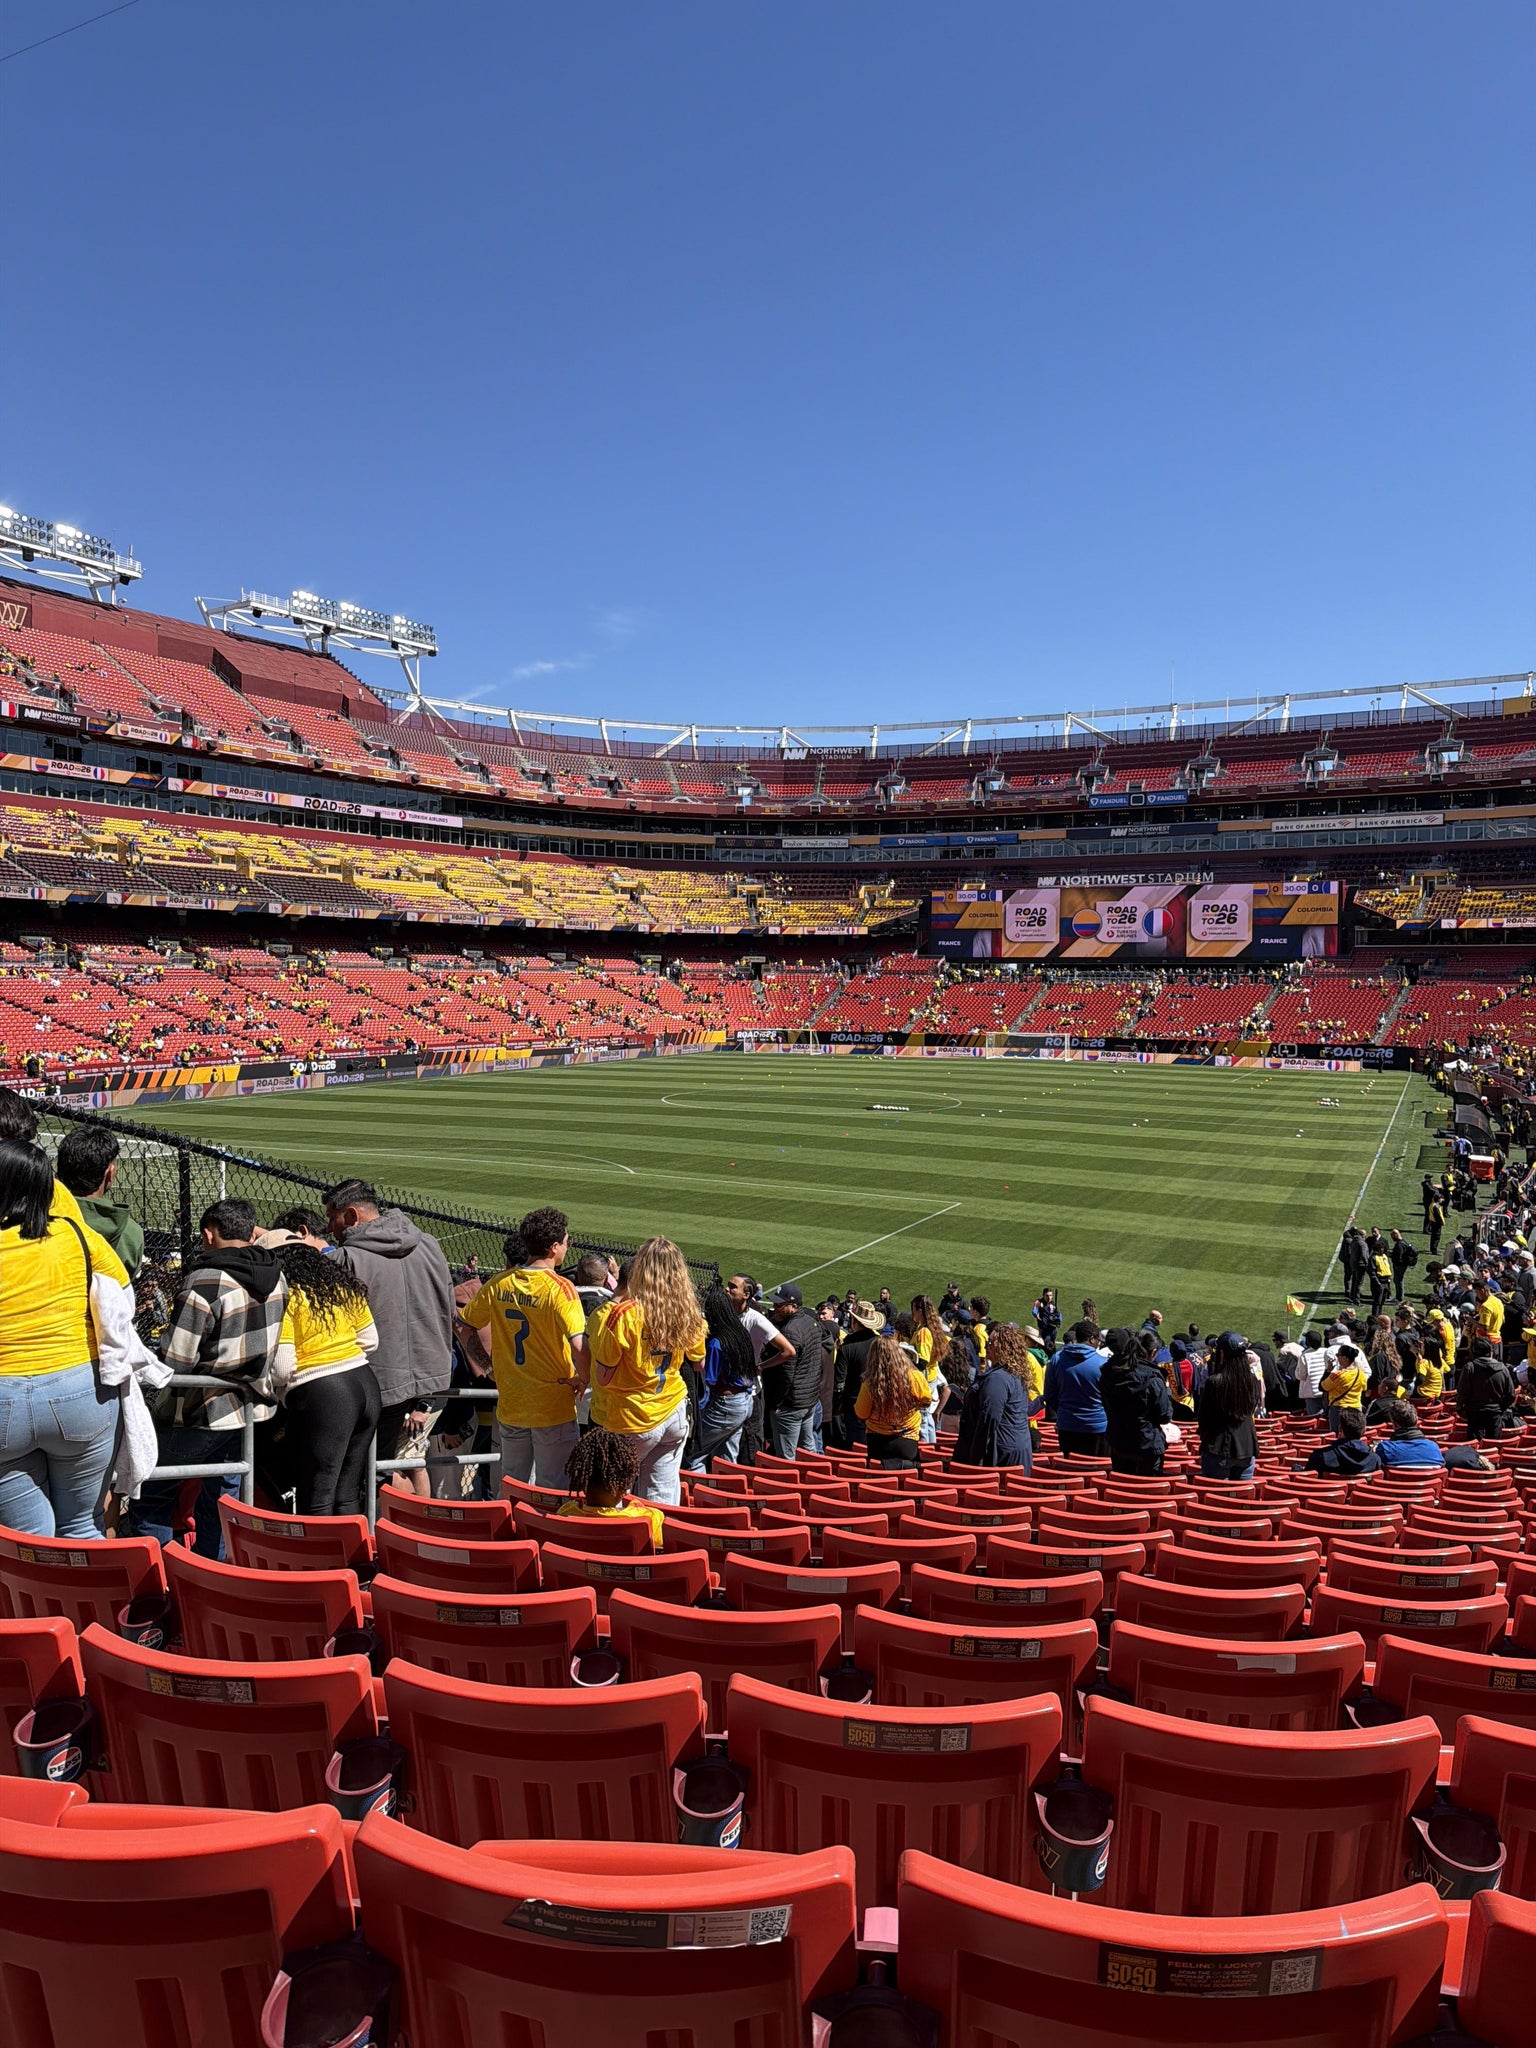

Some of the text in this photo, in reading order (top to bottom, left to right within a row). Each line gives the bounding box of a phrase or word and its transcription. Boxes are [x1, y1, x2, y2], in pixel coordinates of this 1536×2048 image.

[41, 711, 82, 723] NORTHWEST
[809, 747, 863, 755] NORTHWEST
[51, 761, 75, 771] ROAD
[81, 764, 92, 774] 26
[229, 787, 249, 796] ROAD
[1099, 797, 1129, 805] FANDUEL
[1156, 794, 1187, 802] FANDUEL
[303, 797, 337, 811] ROAD
[347, 803, 362, 815] 26
[429, 816, 449, 824] AIRLINES
[1388, 817, 1423, 825] AMERICA
[1128, 825, 1171, 833] NORTHWEST
[974, 835, 998, 843] FANDUEL
[1060, 873, 1146, 886] NORTHWEST
[1147, 871, 1214, 883] STADIUM
[1272, 885, 1279, 893] 0
[168, 894, 189, 904] ROAD
[1015, 907, 1047, 916] ROAD
[1107, 905, 1138, 914] ROAD
[1202, 903, 1239, 913] ROAD
[1026, 915, 1047, 927] 26
[1118, 913, 1137, 924] 26
[1215, 912, 1238, 925] 26
[736, 1031, 760, 1039] ROAD
[830, 1033, 862, 1043] ROAD
[870, 1033, 884, 1043] 26
[1089, 1038, 1106, 1048] 26
[938, 1046, 958, 1054] ROAD
[1100, 1051, 1122, 1059] ROAD
[325, 1060, 337, 1071] 26
[256, 1077, 295, 1088] ROAD 26
[327, 1074, 350, 1085] ROAD
[354, 1073, 365, 1082] 26
[76, 1093, 90, 1103] 26
[496, 1289, 515, 1304] LUIS
[505, 1308, 530, 1366] 7
[1493, 1675, 1517, 1687] 5050
[848, 1728, 876, 1744] 5050
[49, 1753, 81, 1775] PEPSI
[537, 1906, 657, 1928] THE CONCESSIONS LINE!
[701, 1916, 706, 1924] 1
[698, 1926, 706, 1934] 2
[698, 1935, 706, 1944] 3
[1167, 1961, 1263, 1969] FEELING LUCKY?
[1106, 1961, 1158, 1988] 5050
